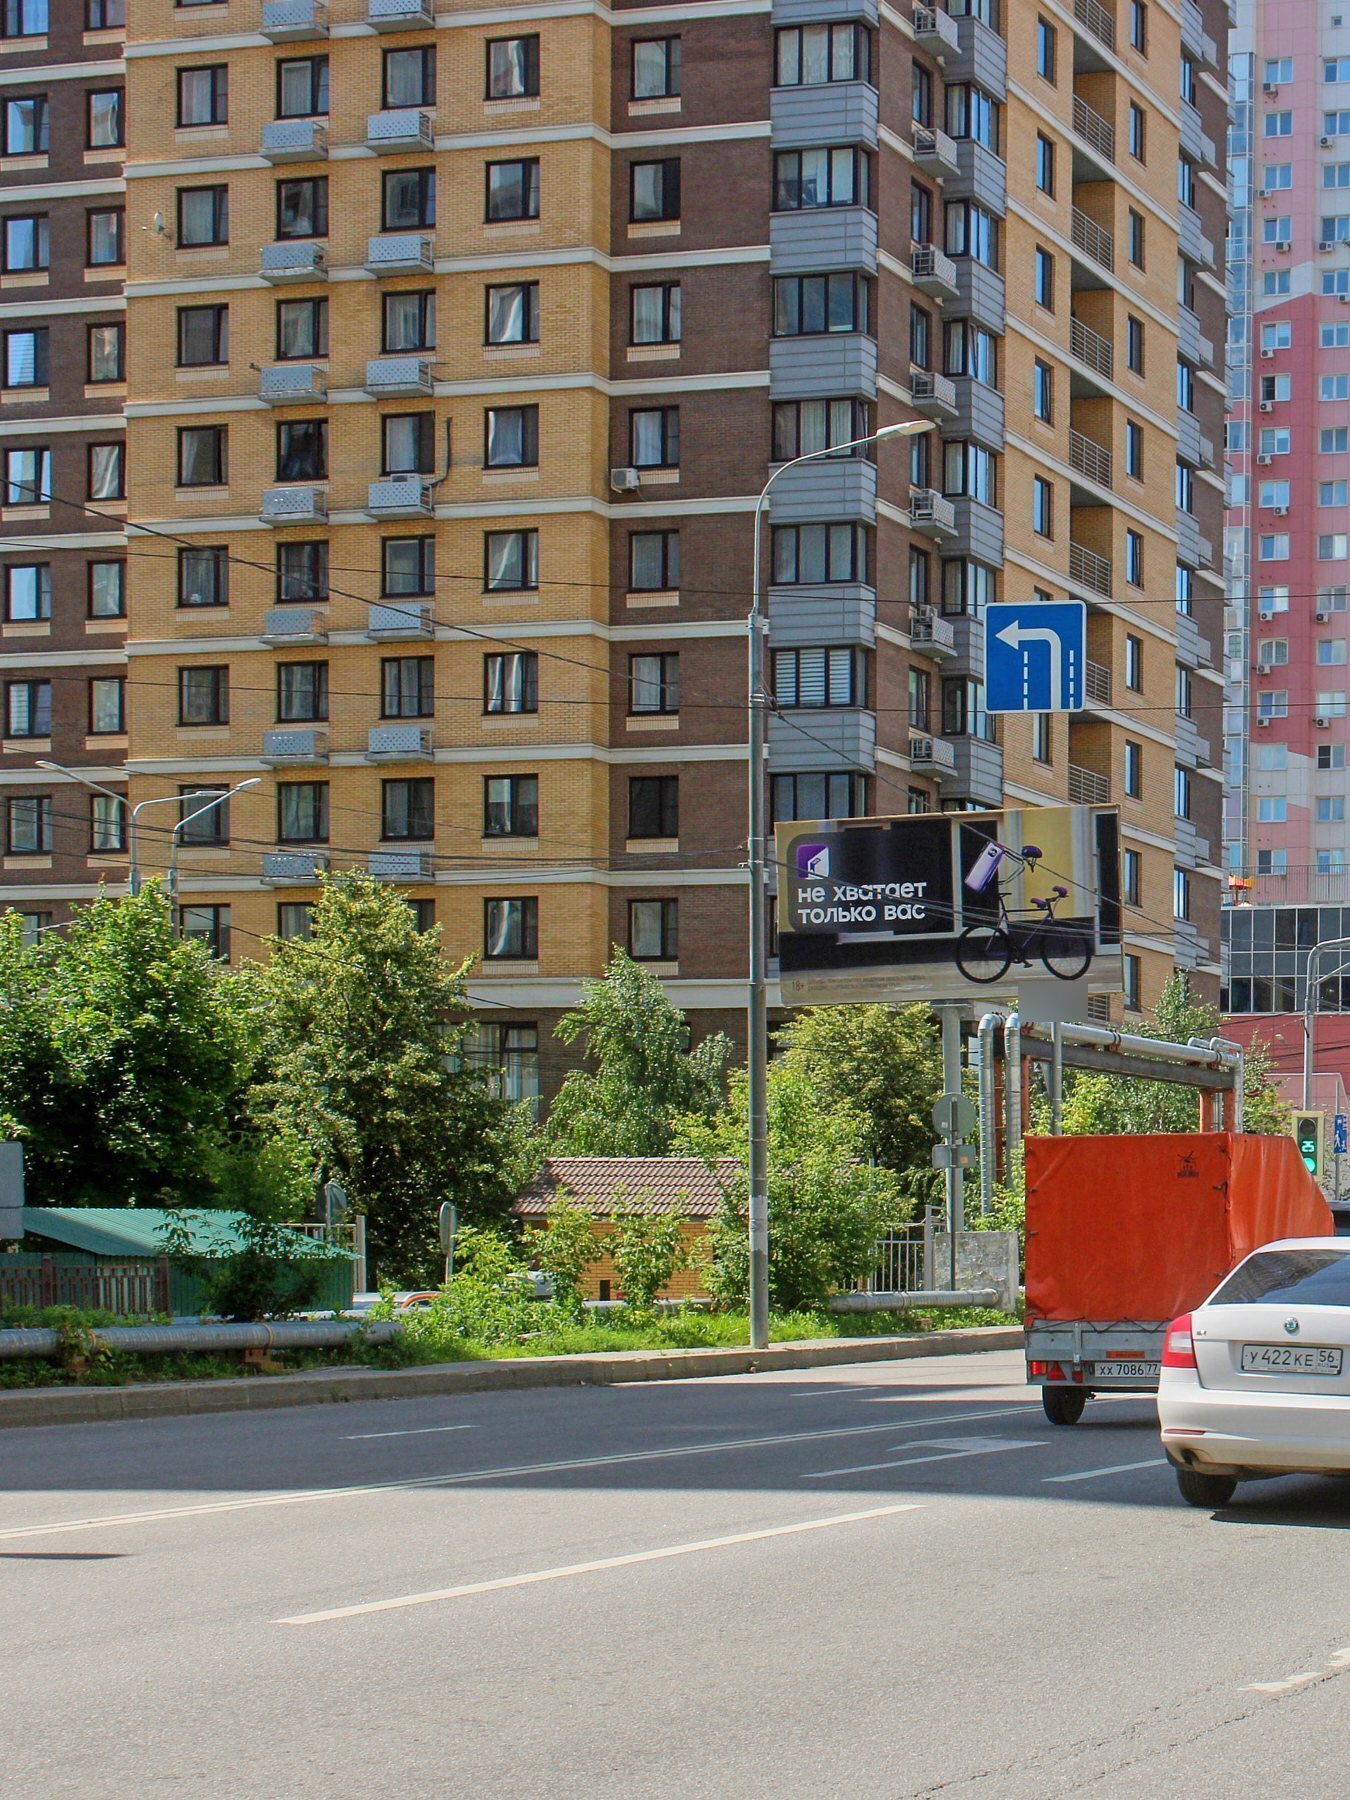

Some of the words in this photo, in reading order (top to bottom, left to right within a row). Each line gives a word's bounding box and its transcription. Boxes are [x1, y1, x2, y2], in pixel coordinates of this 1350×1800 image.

[798, 886, 825, 902] не
[833, 882, 927, 901] хватает
[798, 905, 877, 923] только
[884, 904, 926, 920] вас
[1301, 1140, 1314, 1152] 25
